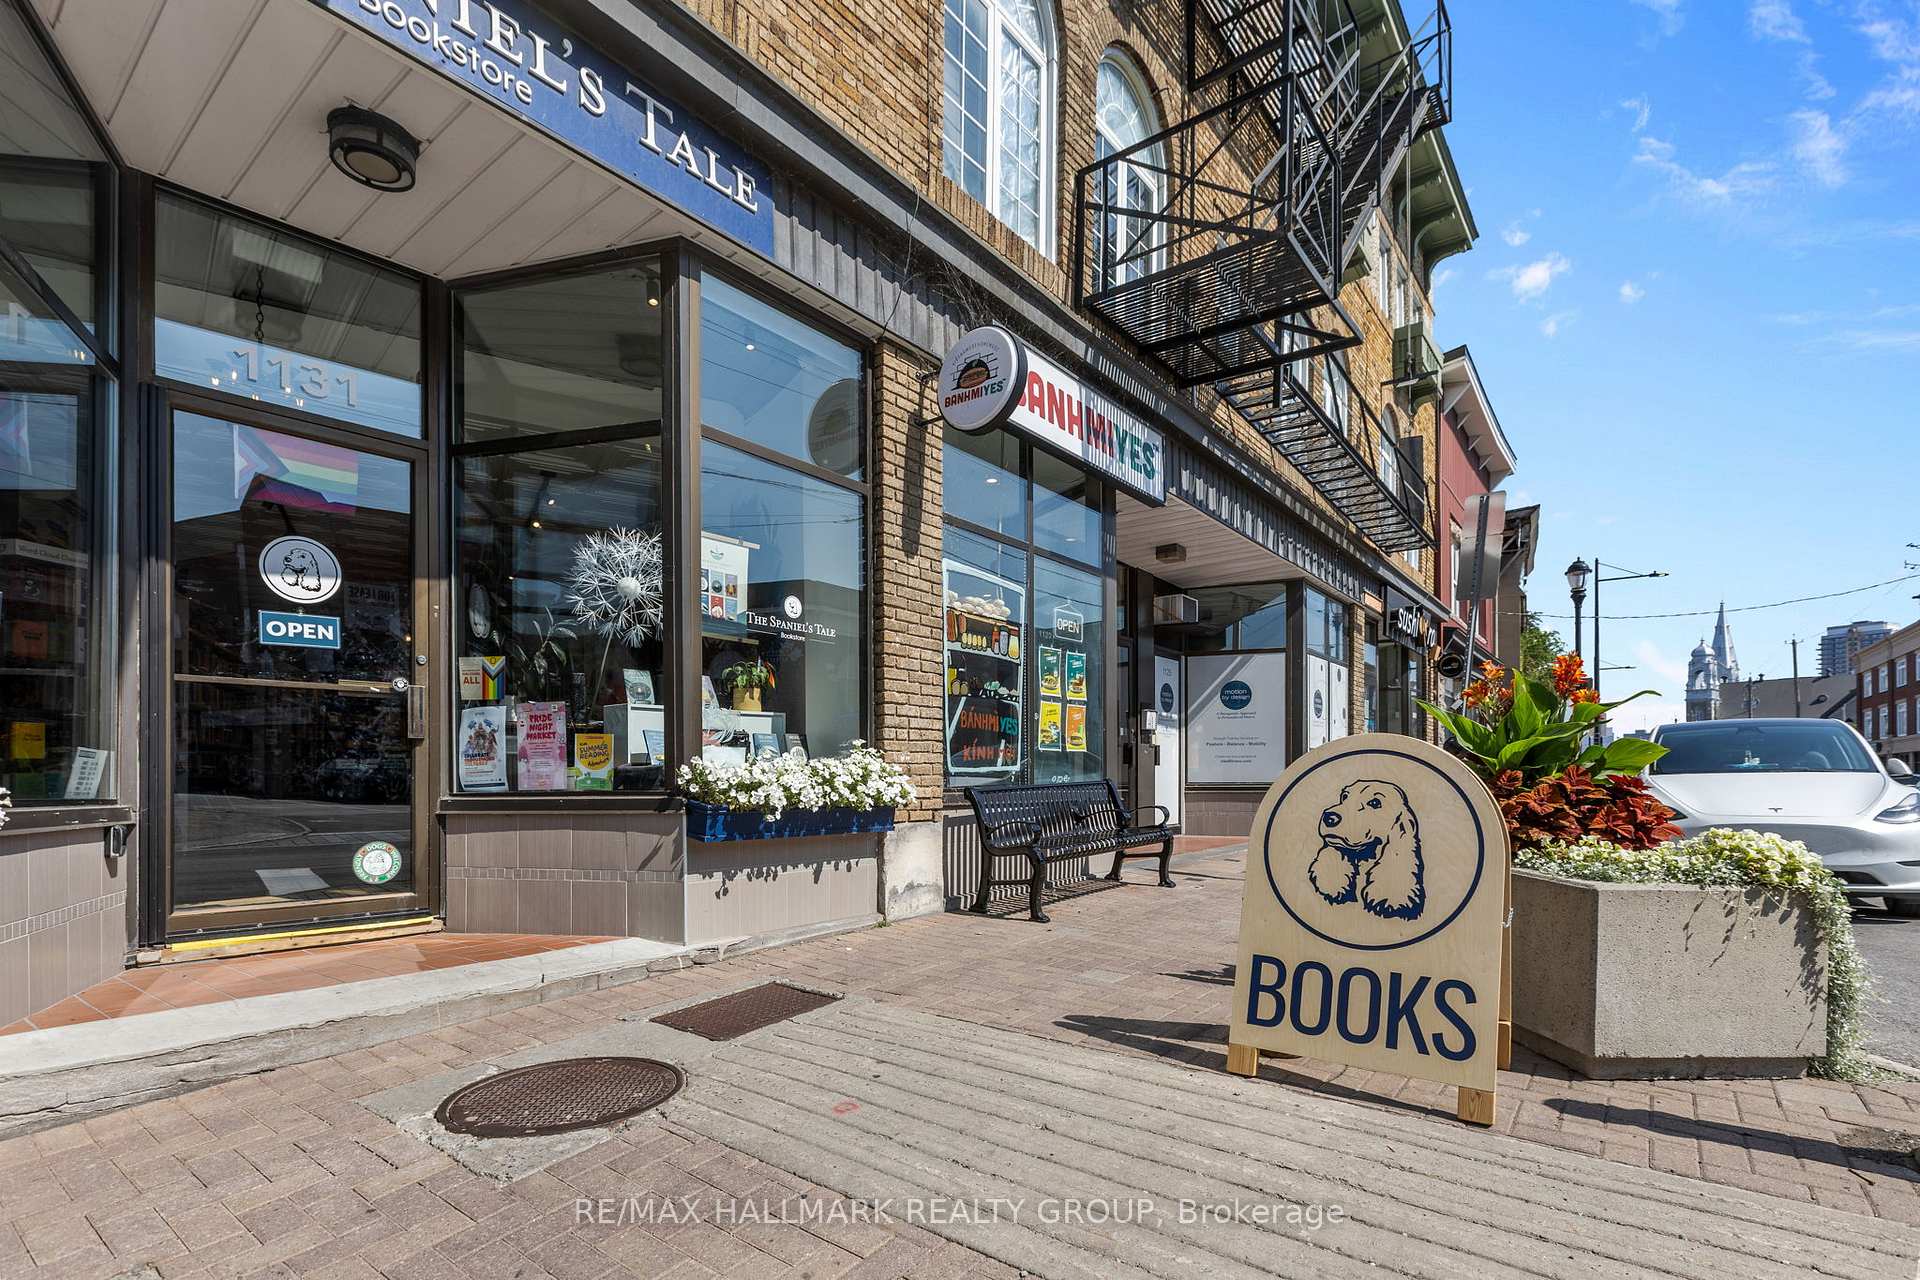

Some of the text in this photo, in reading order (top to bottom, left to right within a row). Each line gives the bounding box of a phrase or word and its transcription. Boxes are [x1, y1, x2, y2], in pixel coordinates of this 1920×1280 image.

[420, 0, 758, 213] IEL'S TALE
[232, 346, 360, 407] 1131
[1019, 371, 1156, 480] ANHMIYES
[266, 620, 334, 641] OPEN
[746, 611, 836, 638] THE SPANIEL'S TALE
[1056, 618, 1080, 634] OPEN
[780, 631, 806, 641] Bookstore
[463, 676, 480, 685] ALL
[528, 722, 554, 732] NIGHT
[529, 713, 553, 723] PRIDE
[526, 732, 556, 741] MARKET
[1247, 954, 1477, 1062] BOOKS
